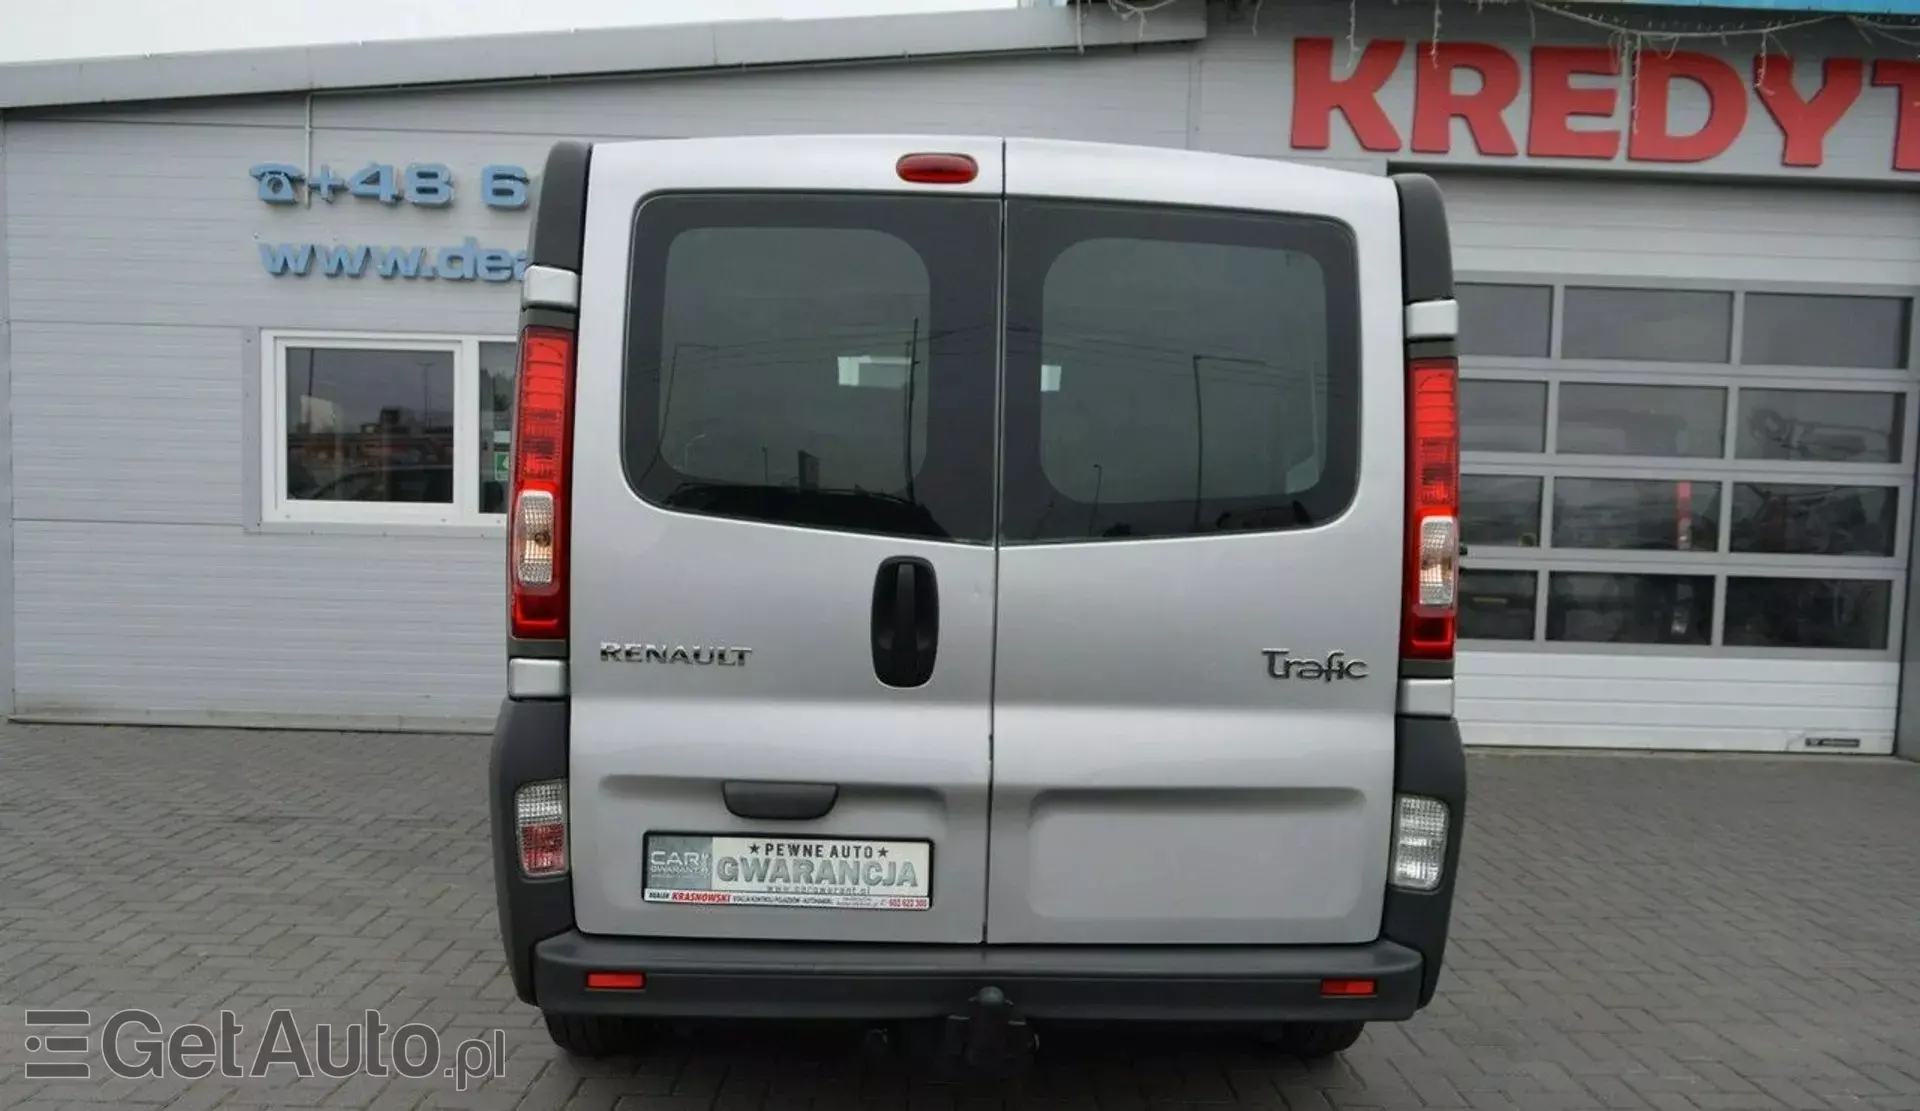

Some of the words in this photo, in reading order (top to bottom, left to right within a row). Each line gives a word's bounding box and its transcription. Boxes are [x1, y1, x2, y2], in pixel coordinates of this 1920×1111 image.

[1289, 36, 1920, 172] KREDYT
[307, 163, 456, 206] +48
[481, 164, 530, 207] 6
[600, 642, 752, 667] RENAULT
[1262, 648, 1369, 682] Trafic
[651, 851, 699, 865] CAR
[765, 843, 823, 858] PEWNE
[829, 845, 873, 859] AUTO
[717, 856, 918, 888] GWARANCJA
[672, 892, 731, 902] KRASNOWSKI
